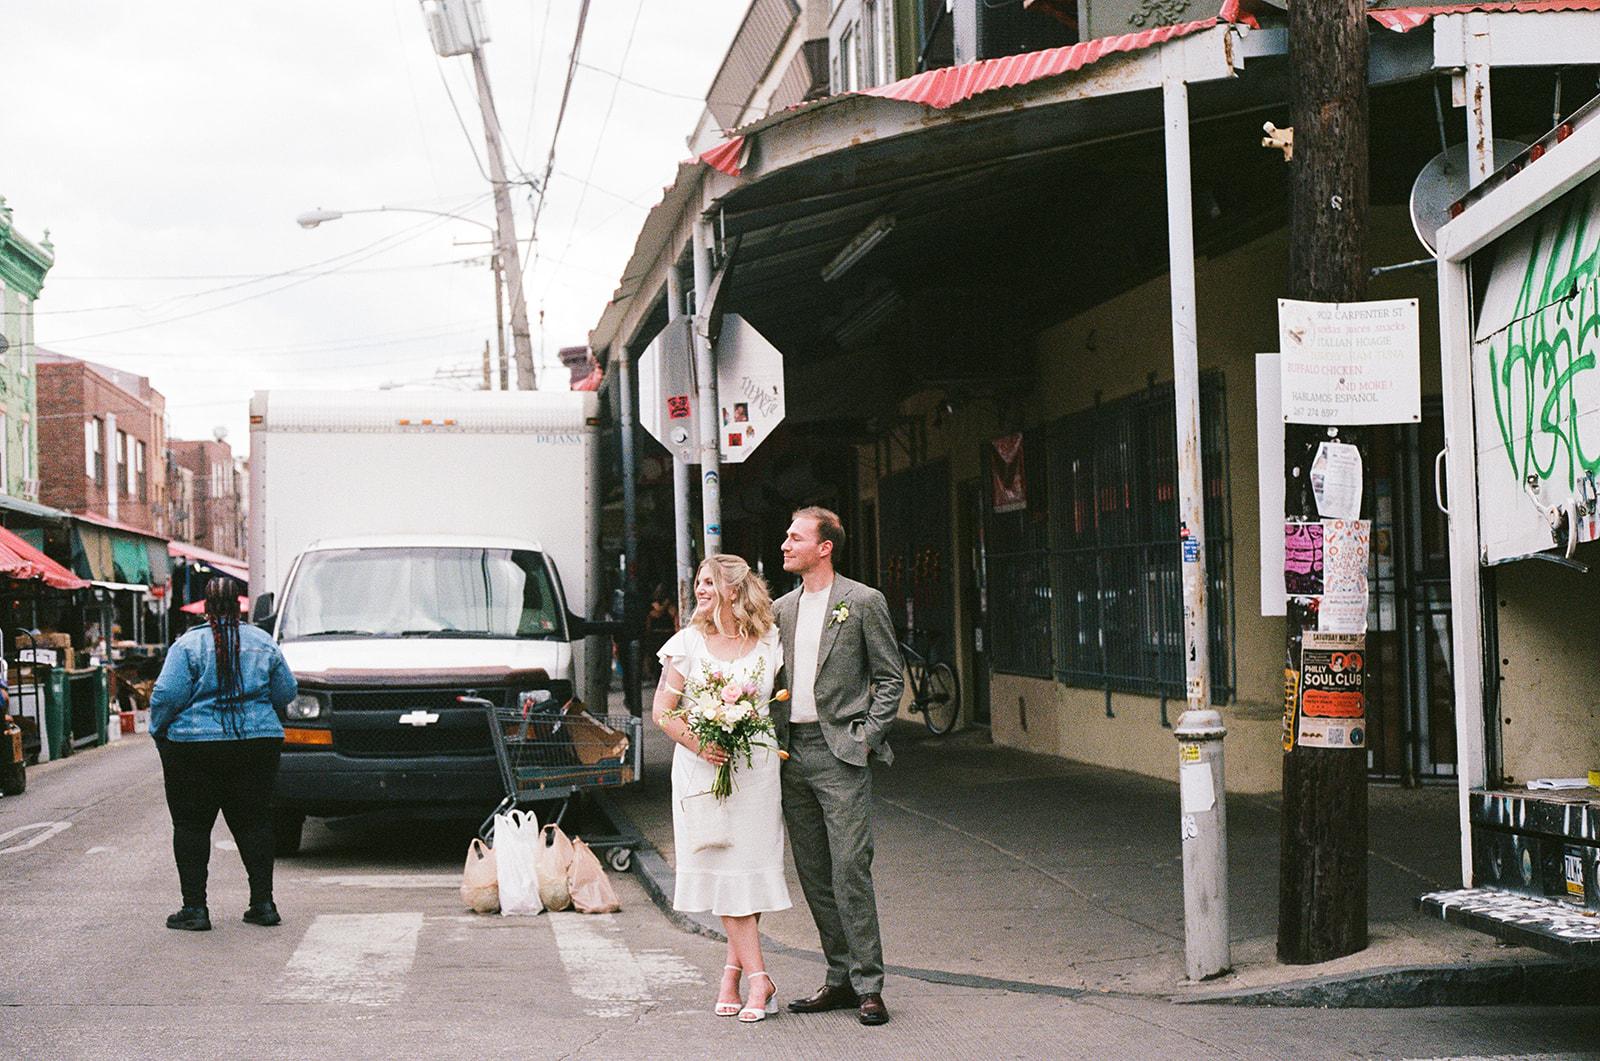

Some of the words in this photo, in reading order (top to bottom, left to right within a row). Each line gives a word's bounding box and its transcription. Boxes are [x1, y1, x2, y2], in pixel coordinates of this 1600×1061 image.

[1335, 309, 1390, 321] CARPENTER
[1392, 307, 1404, 318] ST
[1317, 336, 1353, 348] ITALIAN
[1356, 335, 1392, 347] HOAGIE
[1288, 362, 1321, 375] BUFFALO
[1322, 364, 1362, 376] CHICKEN
[1335, 381, 1356, 391] AND
[536, 434, 582, 445] DEJANA
[1304, 665, 1327, 674] PHILLY
[1304, 673, 1336, 686] SOUL
[1336, 673, 1362, 686] CLUB
